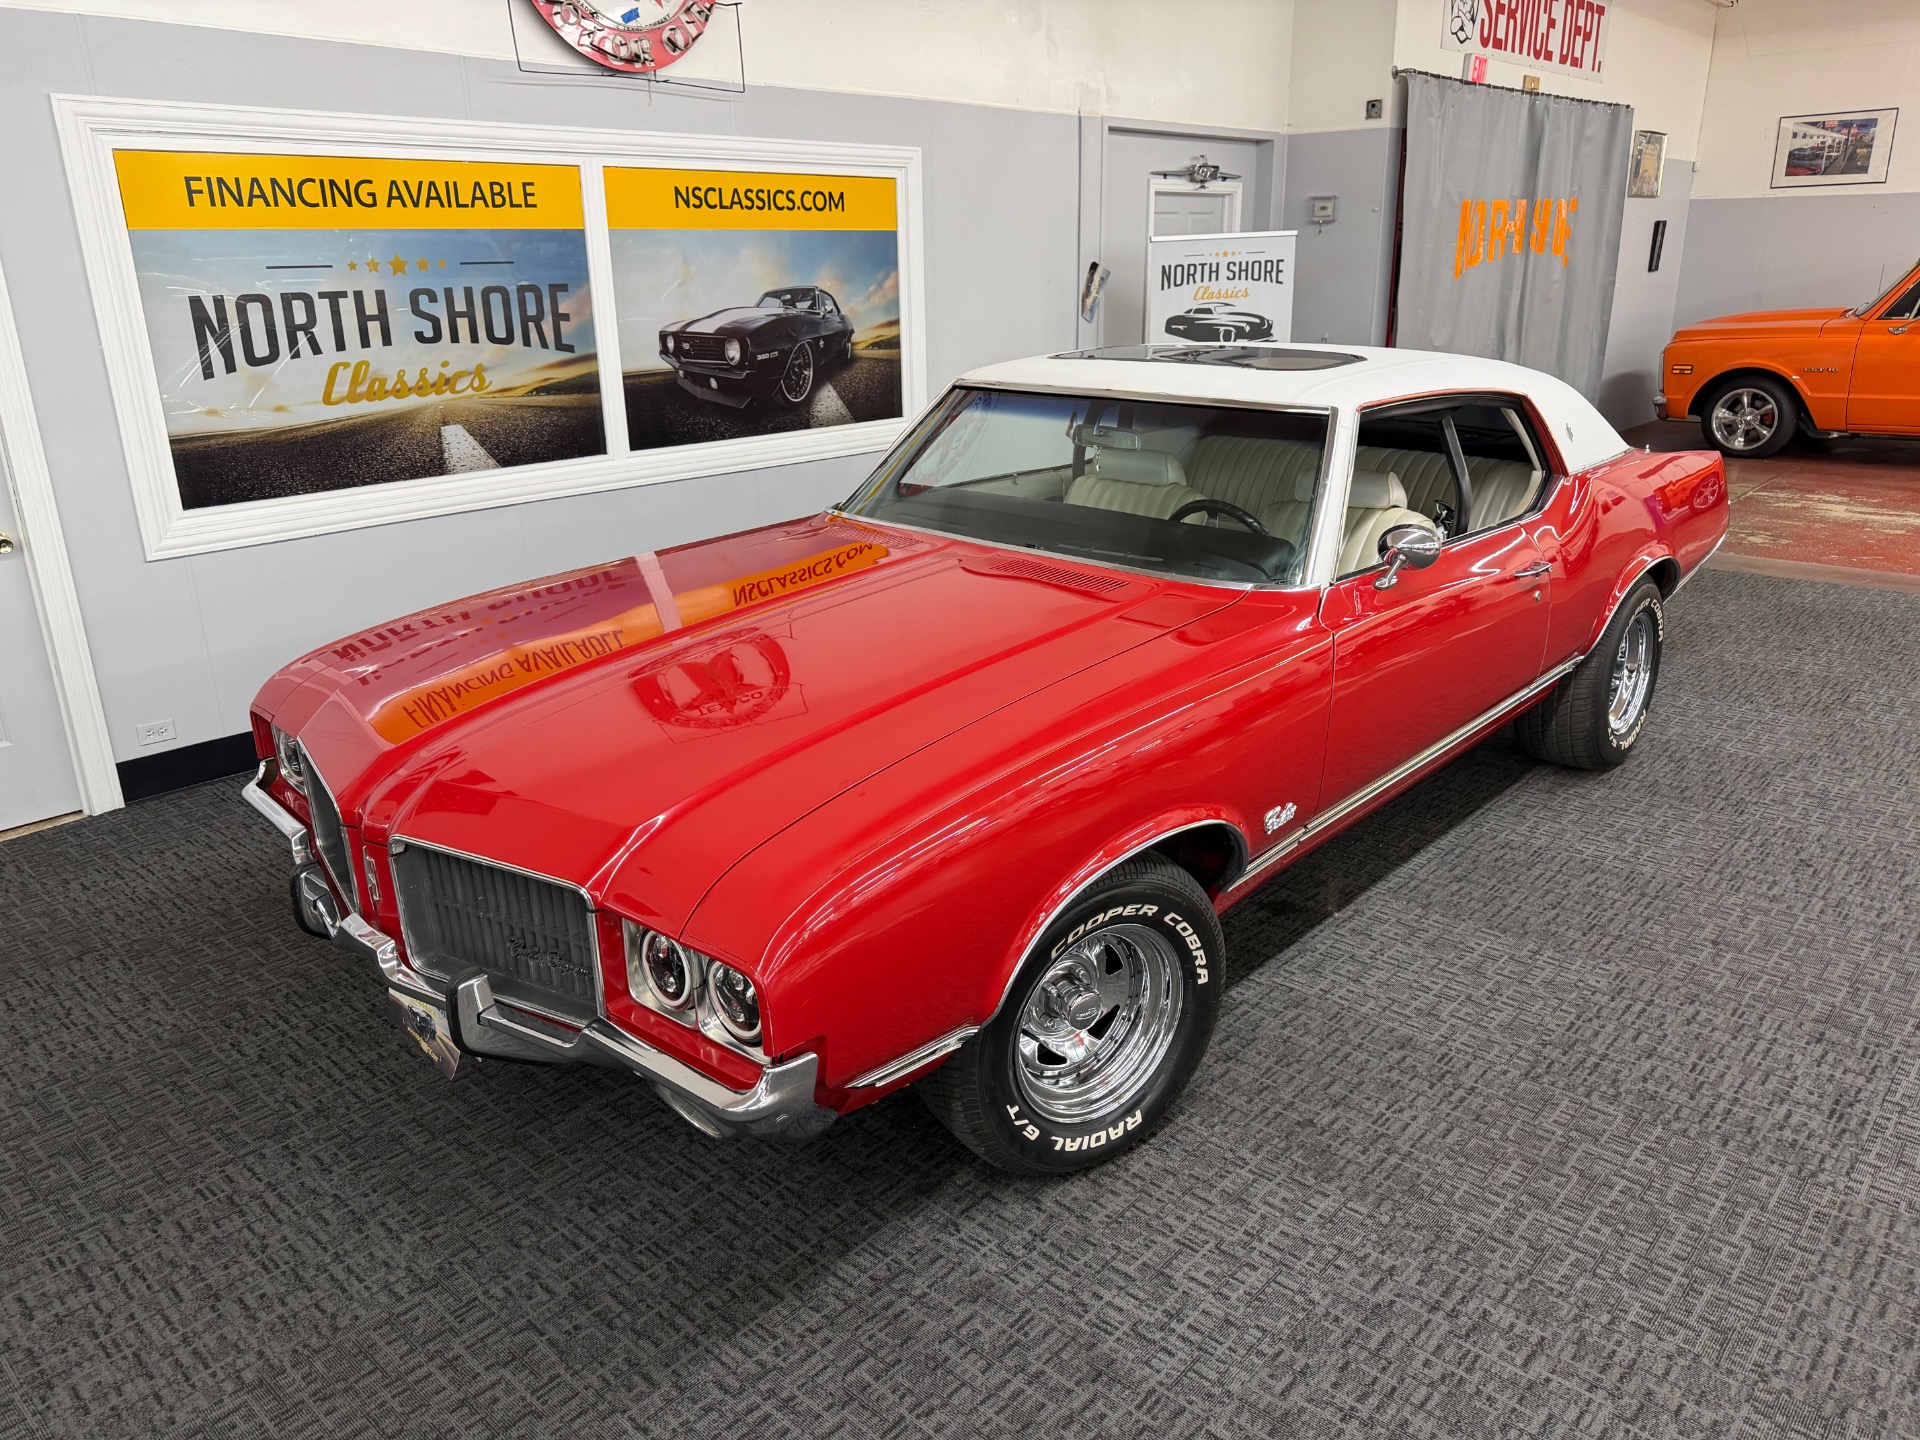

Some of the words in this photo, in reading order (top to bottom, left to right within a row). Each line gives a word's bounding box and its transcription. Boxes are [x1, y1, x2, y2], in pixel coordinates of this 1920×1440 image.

[1479, 0, 1559, 62] SERVICE
[1558, 0, 1606, 73] DEPT.
[184, 176, 378, 207] FINANCING
[387, 180, 538, 208] AVAILABLE
[673, 185, 846, 213] NSCLASSICS.COM
[1160, 262, 1220, 291] NORTH
[1226, 258, 1284, 285] SHORE
[1193, 285, 1250, 301] Classics
[188, 289, 393, 381] NORTH
[409, 283, 576, 353] SHORE
[321, 359, 493, 406] Classics
[1050, 903, 1159, 960] COOPER
[1163, 911, 1210, 985] COBRA
[1006, 1104, 1041, 1141] G/T
[1050, 1108, 1143, 1152] RADIAL
